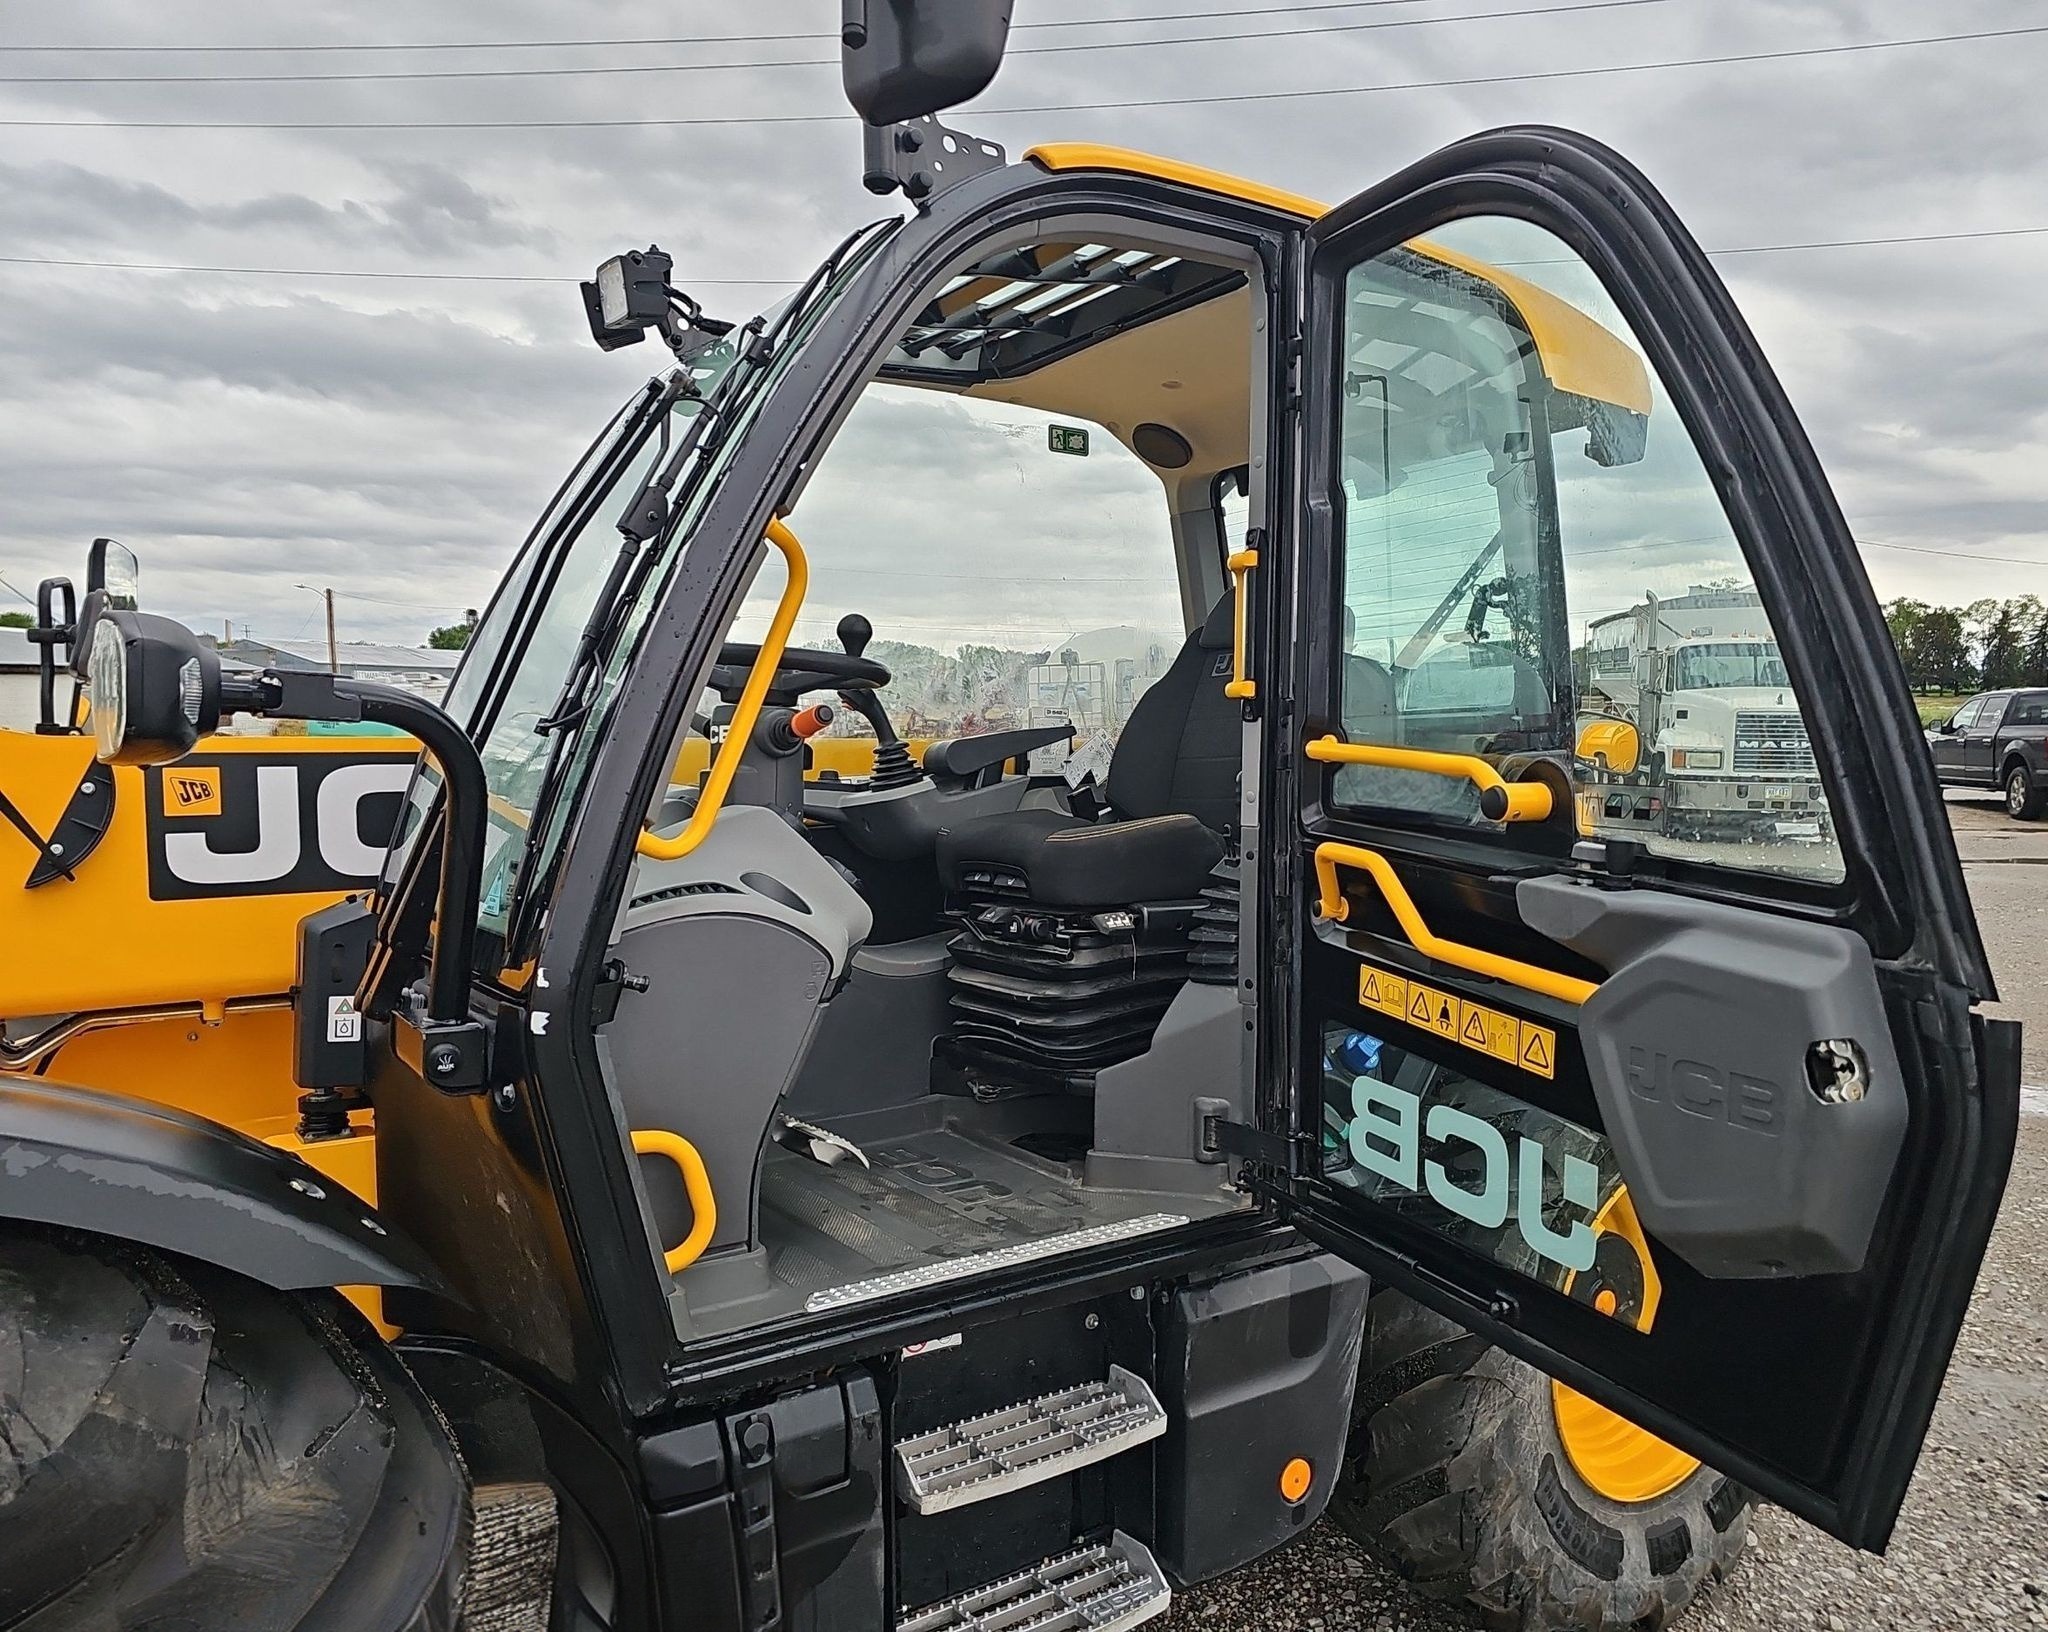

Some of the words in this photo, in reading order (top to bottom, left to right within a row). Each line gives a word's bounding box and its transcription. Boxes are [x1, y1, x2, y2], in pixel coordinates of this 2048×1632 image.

[165, 764, 436, 884] JC
[178, 780, 212, 803] JCB
[1628, 1046, 1786, 1138] JCB
